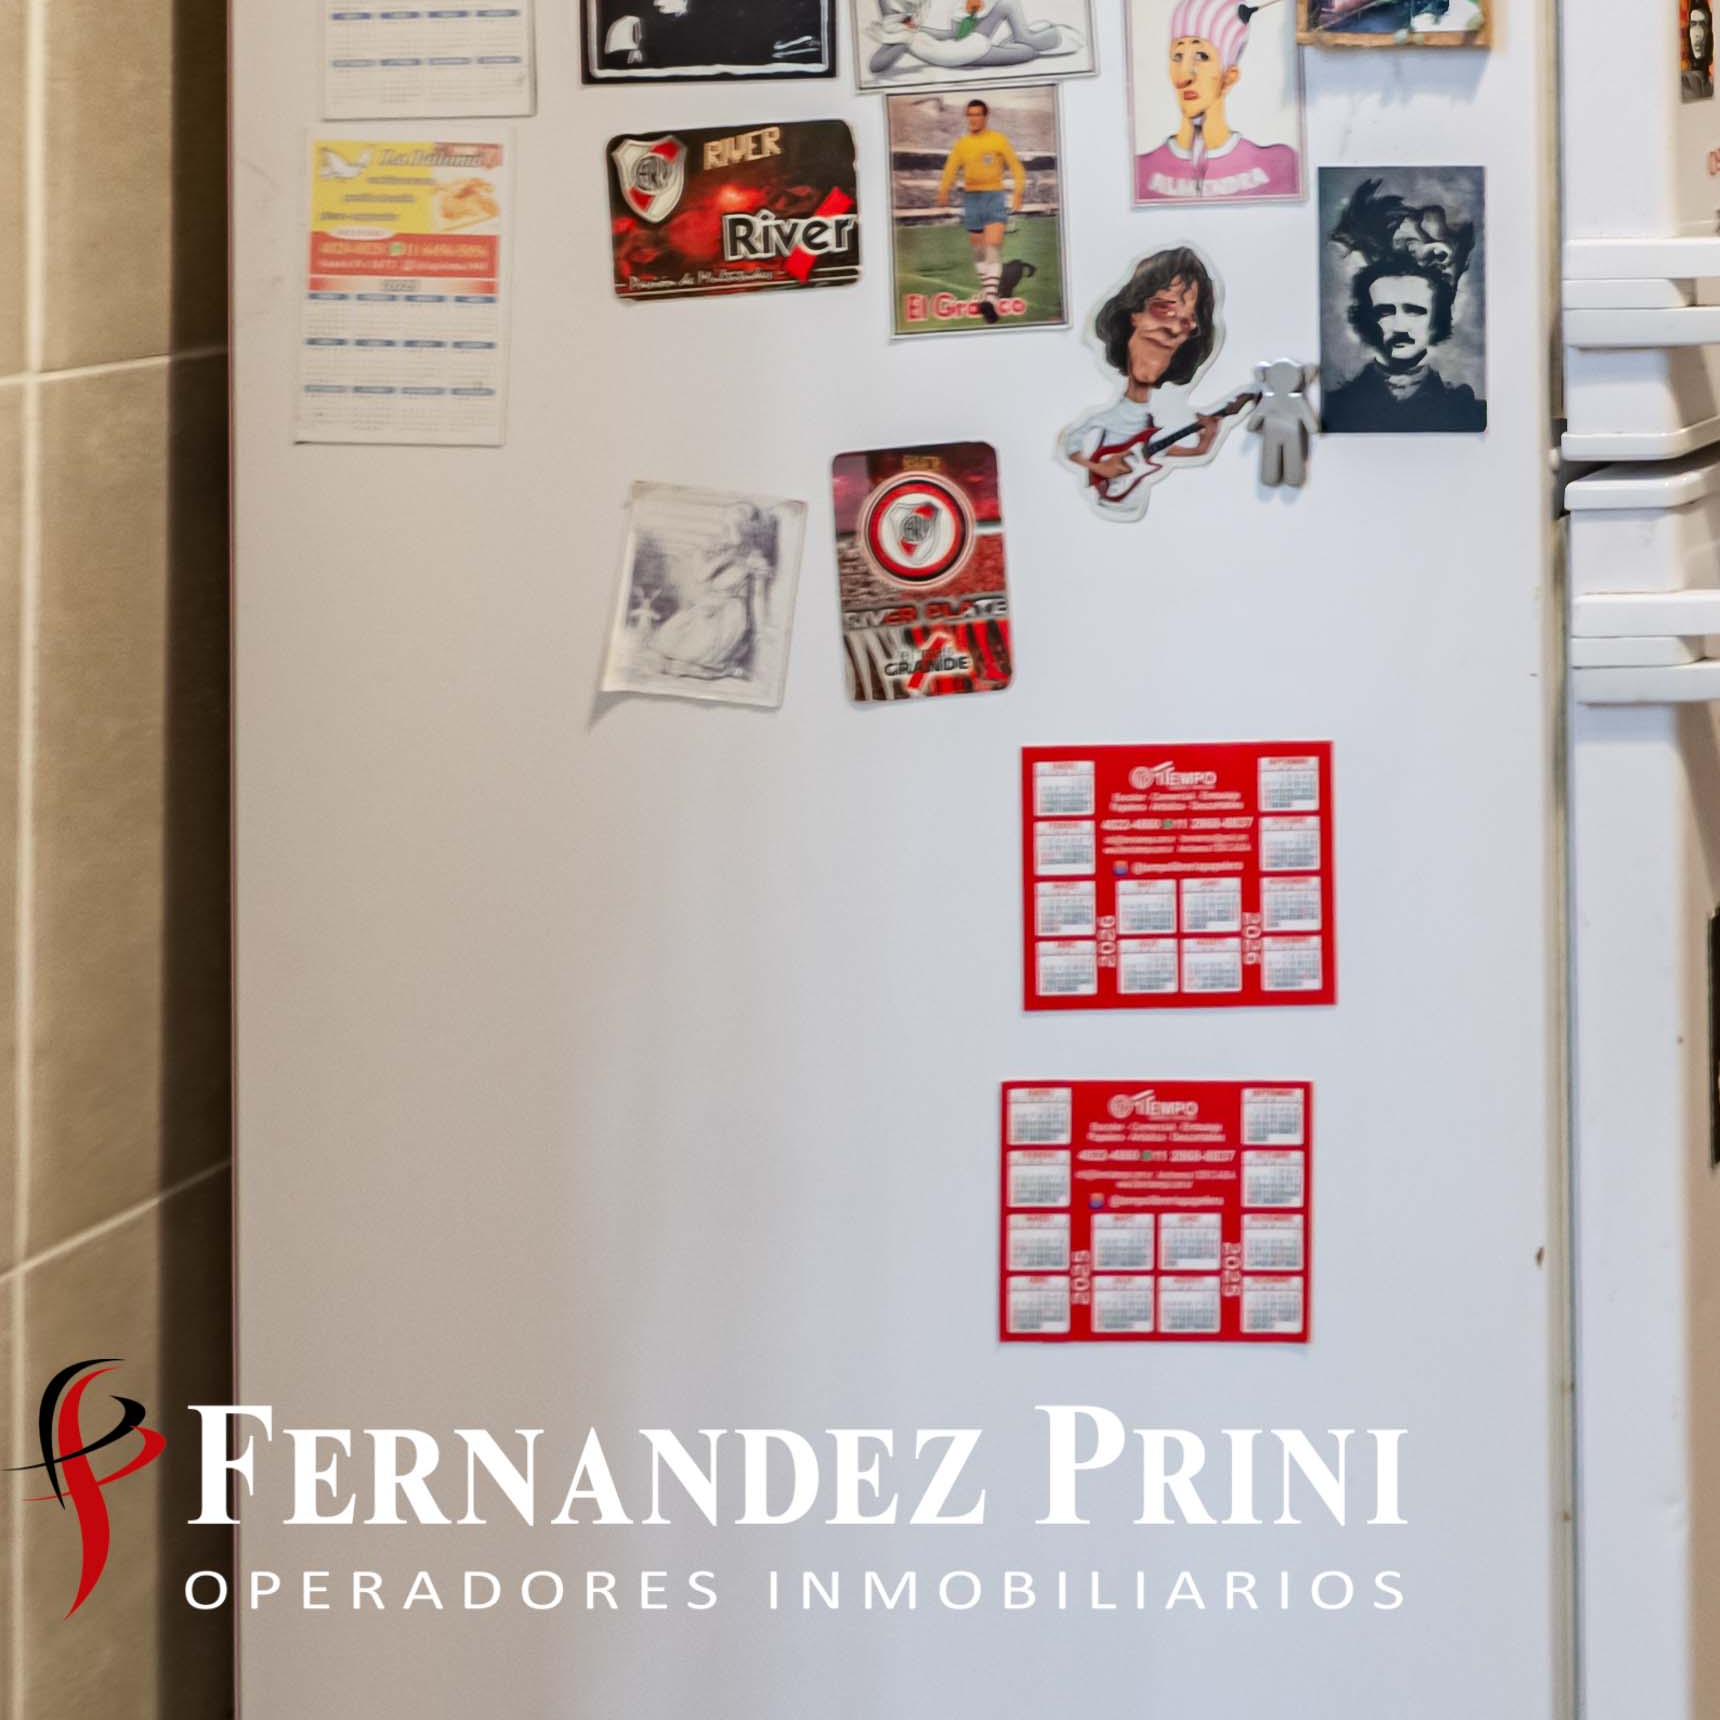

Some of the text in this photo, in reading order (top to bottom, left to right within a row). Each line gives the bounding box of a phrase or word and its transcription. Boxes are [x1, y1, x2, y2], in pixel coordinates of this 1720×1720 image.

[702, 126, 783, 171] RIVER
[722, 209, 860, 261] River
[905, 292, 1028, 322] El Gráco
[884, 656, 970, 677] GRANDE
